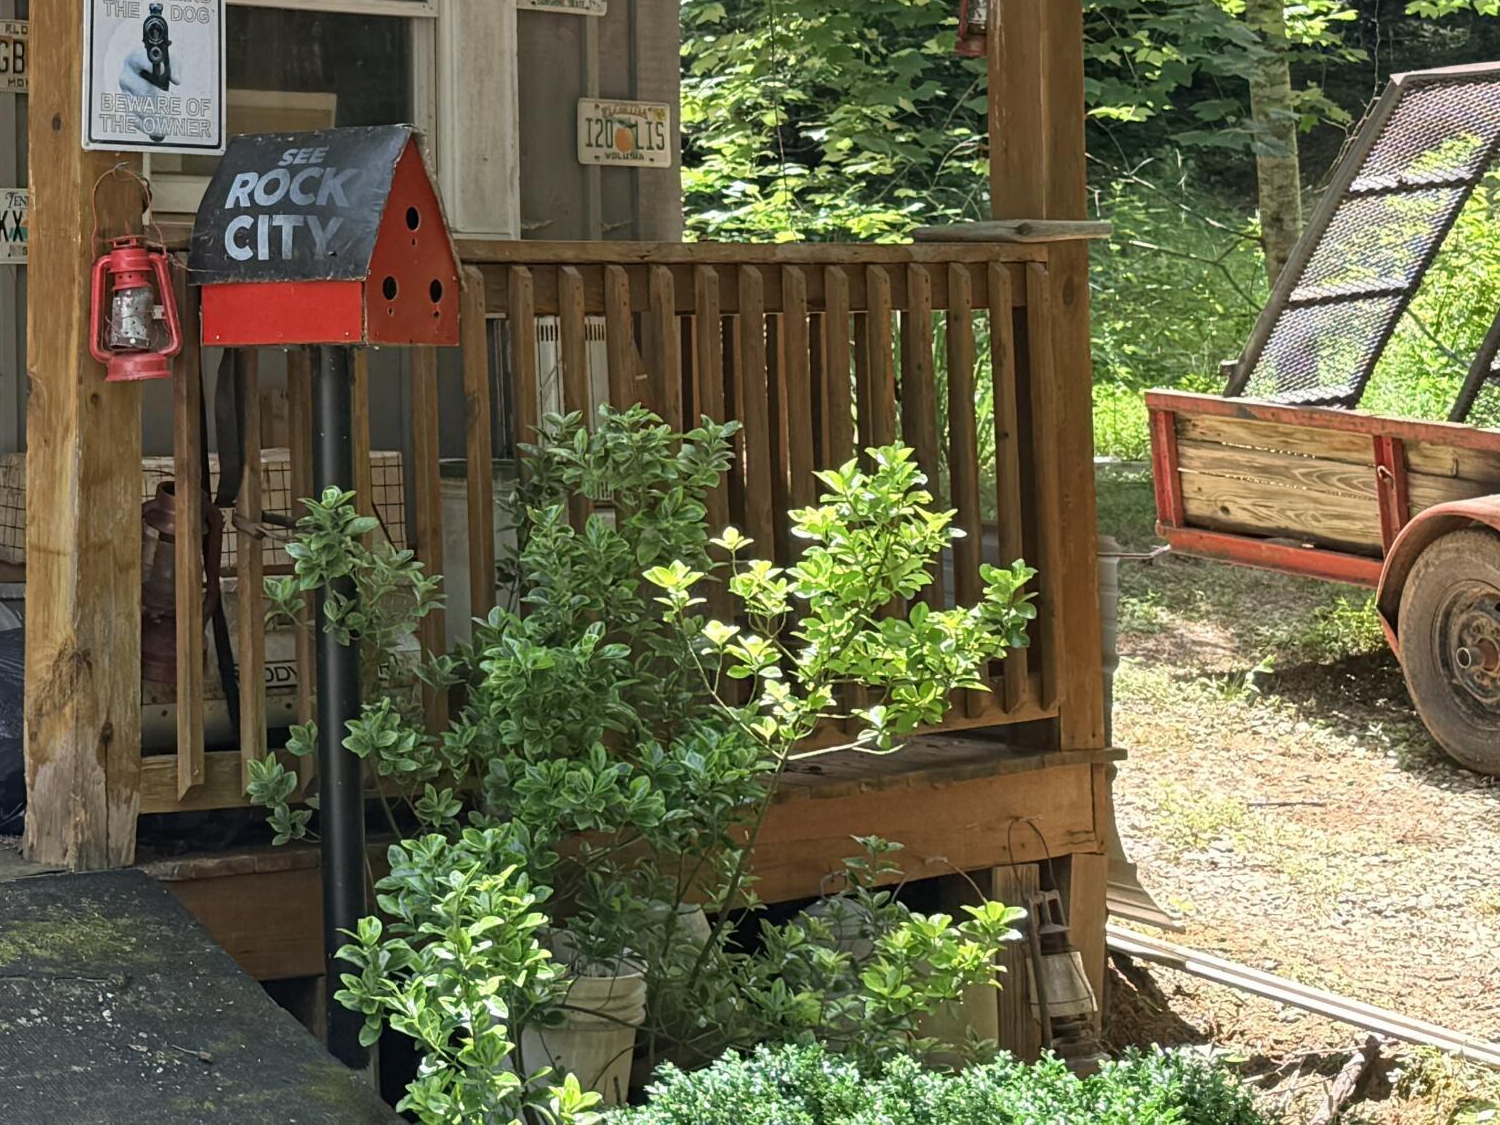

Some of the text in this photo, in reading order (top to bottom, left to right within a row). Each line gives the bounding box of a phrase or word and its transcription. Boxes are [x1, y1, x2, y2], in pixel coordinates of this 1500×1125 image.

[103, 0, 211, 24] THE DOG
[101, 93, 212, 117] BEWARE OF
[100, 114, 212, 137] THE OWNER
[277, 147, 329, 166] SEE
[224, 167, 360, 210] ROCK
[224, 214, 344, 261] CITY
